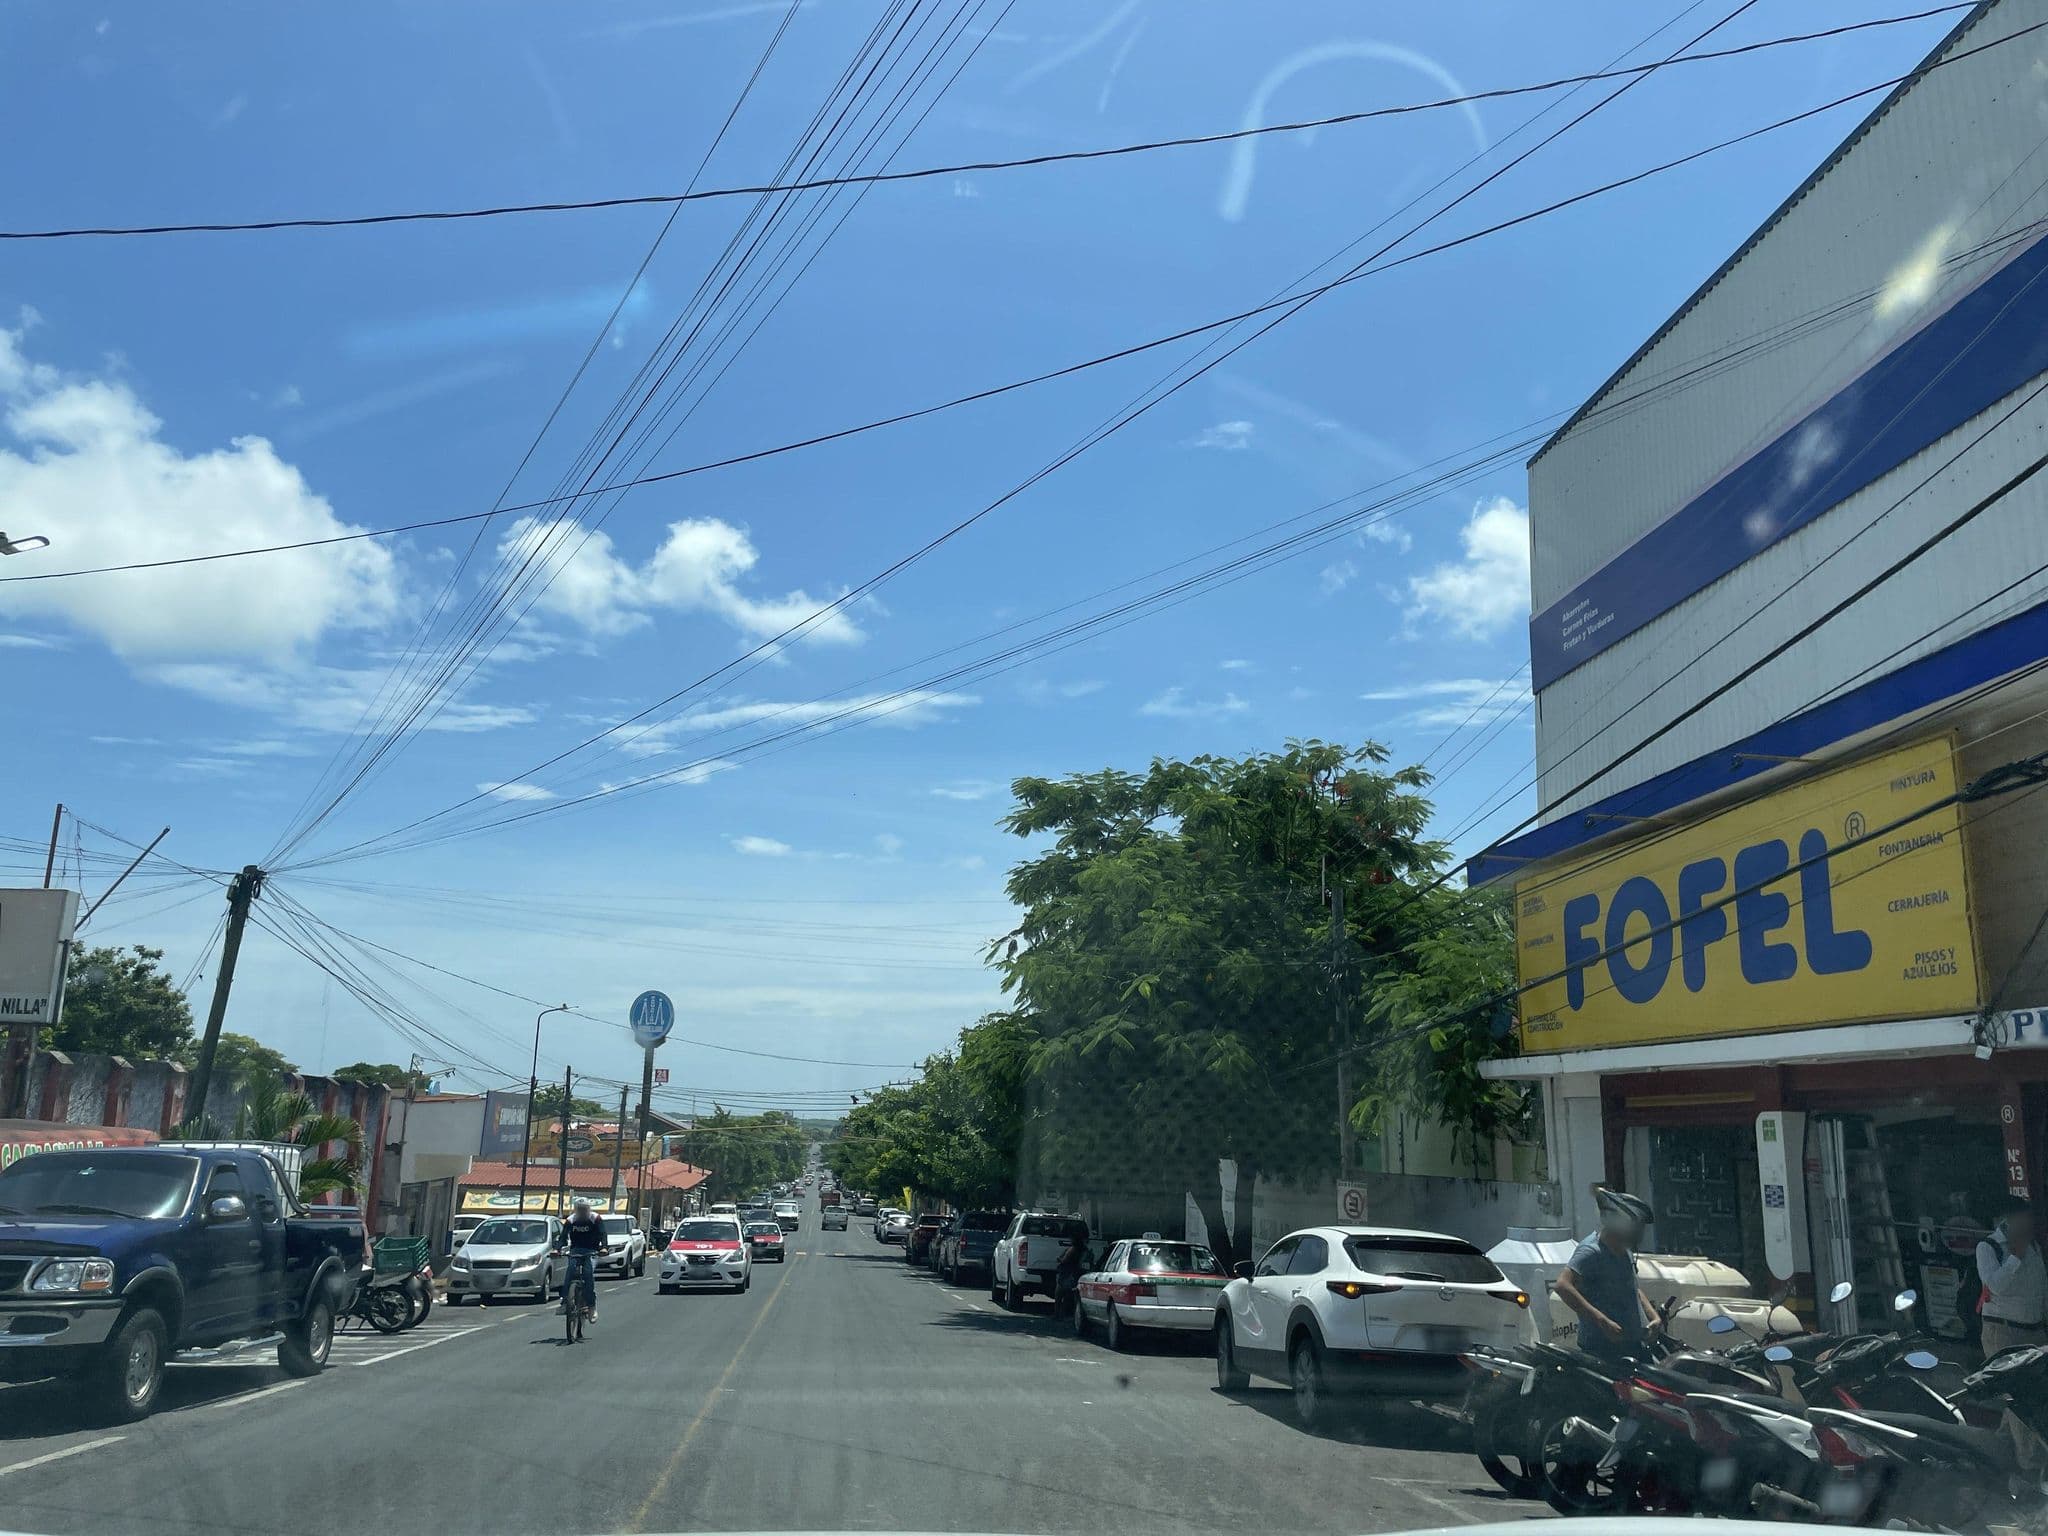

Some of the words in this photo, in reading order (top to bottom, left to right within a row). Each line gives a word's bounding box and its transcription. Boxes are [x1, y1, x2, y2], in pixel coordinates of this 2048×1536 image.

[1562, 618, 1583, 637] Carnes
[1563, 633, 1582, 651] Frutas
[1890, 769, 1936, 793] PINTURA
[1887, 887, 1950, 913] CERRAJERÍA
[1563, 827, 1873, 1012] FOFEL
[1914, 948, 1947, 965] PISOS
[1903, 960, 1958, 981] AZULEJOS
[2009, 1165, 2024, 1181] 13
[1138, 1248, 1161, 1256] 177
